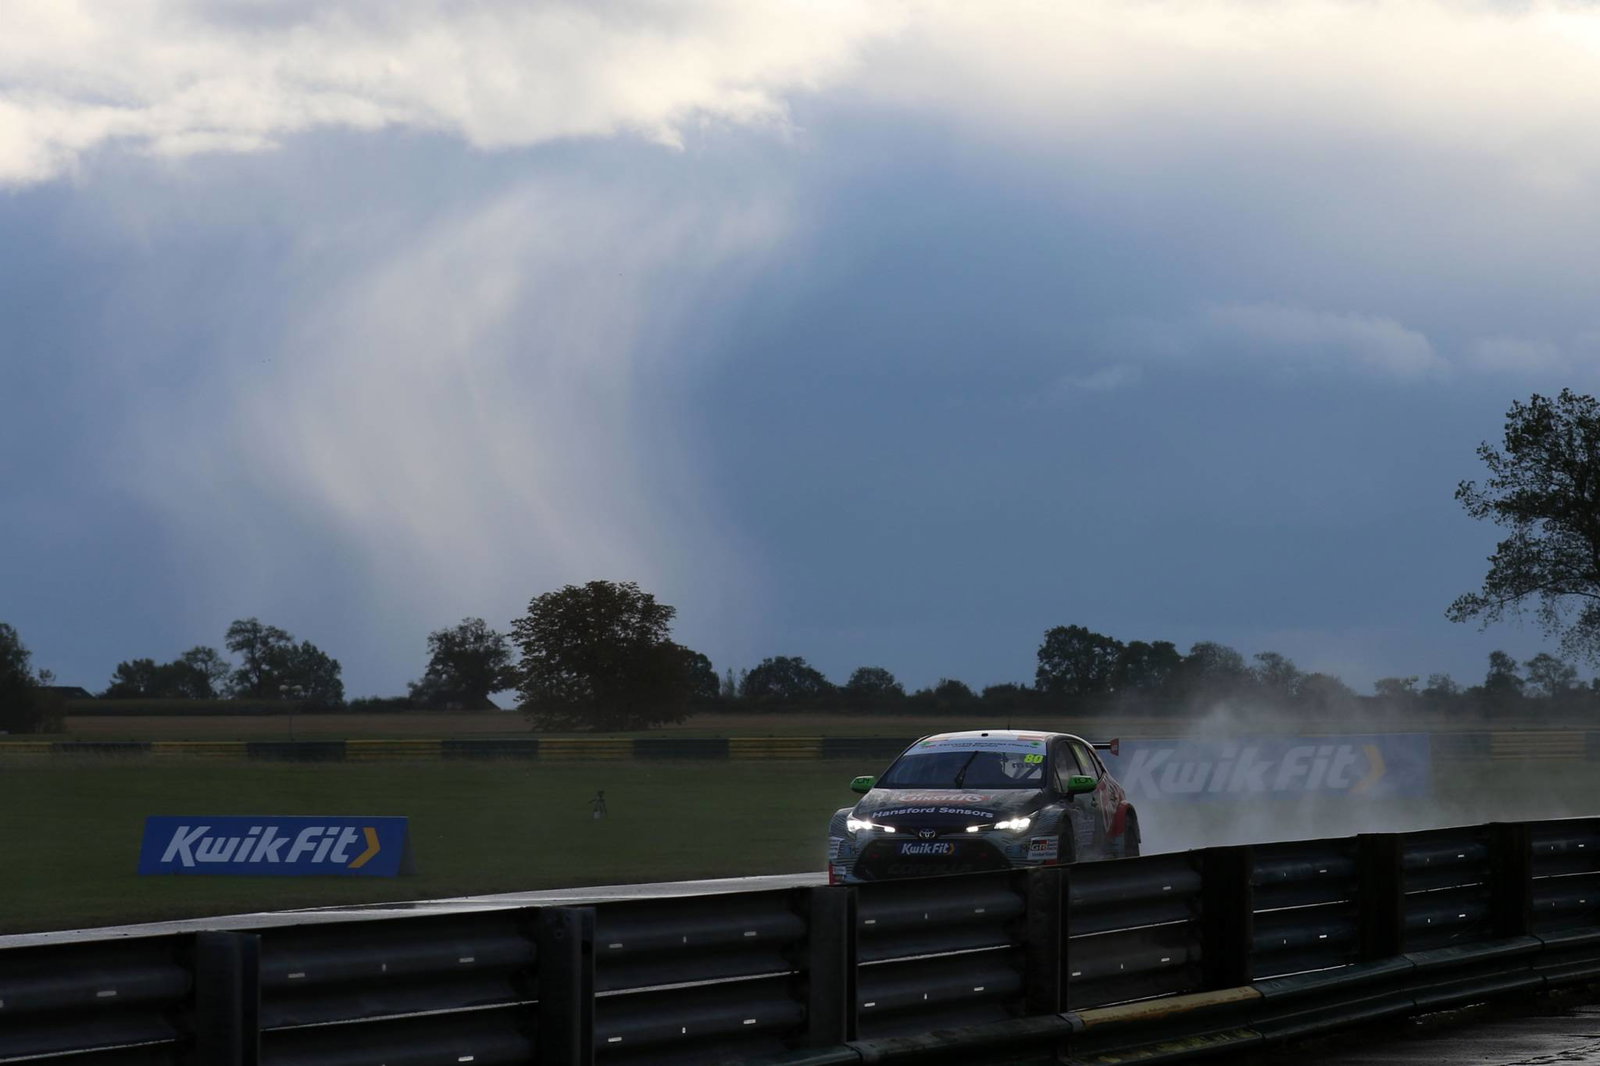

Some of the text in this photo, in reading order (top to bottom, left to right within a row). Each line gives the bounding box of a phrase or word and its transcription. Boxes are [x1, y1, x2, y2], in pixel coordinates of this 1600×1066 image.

[1024, 754, 1044, 764] 80
[872, 807, 994, 819] Hansford Sensors
